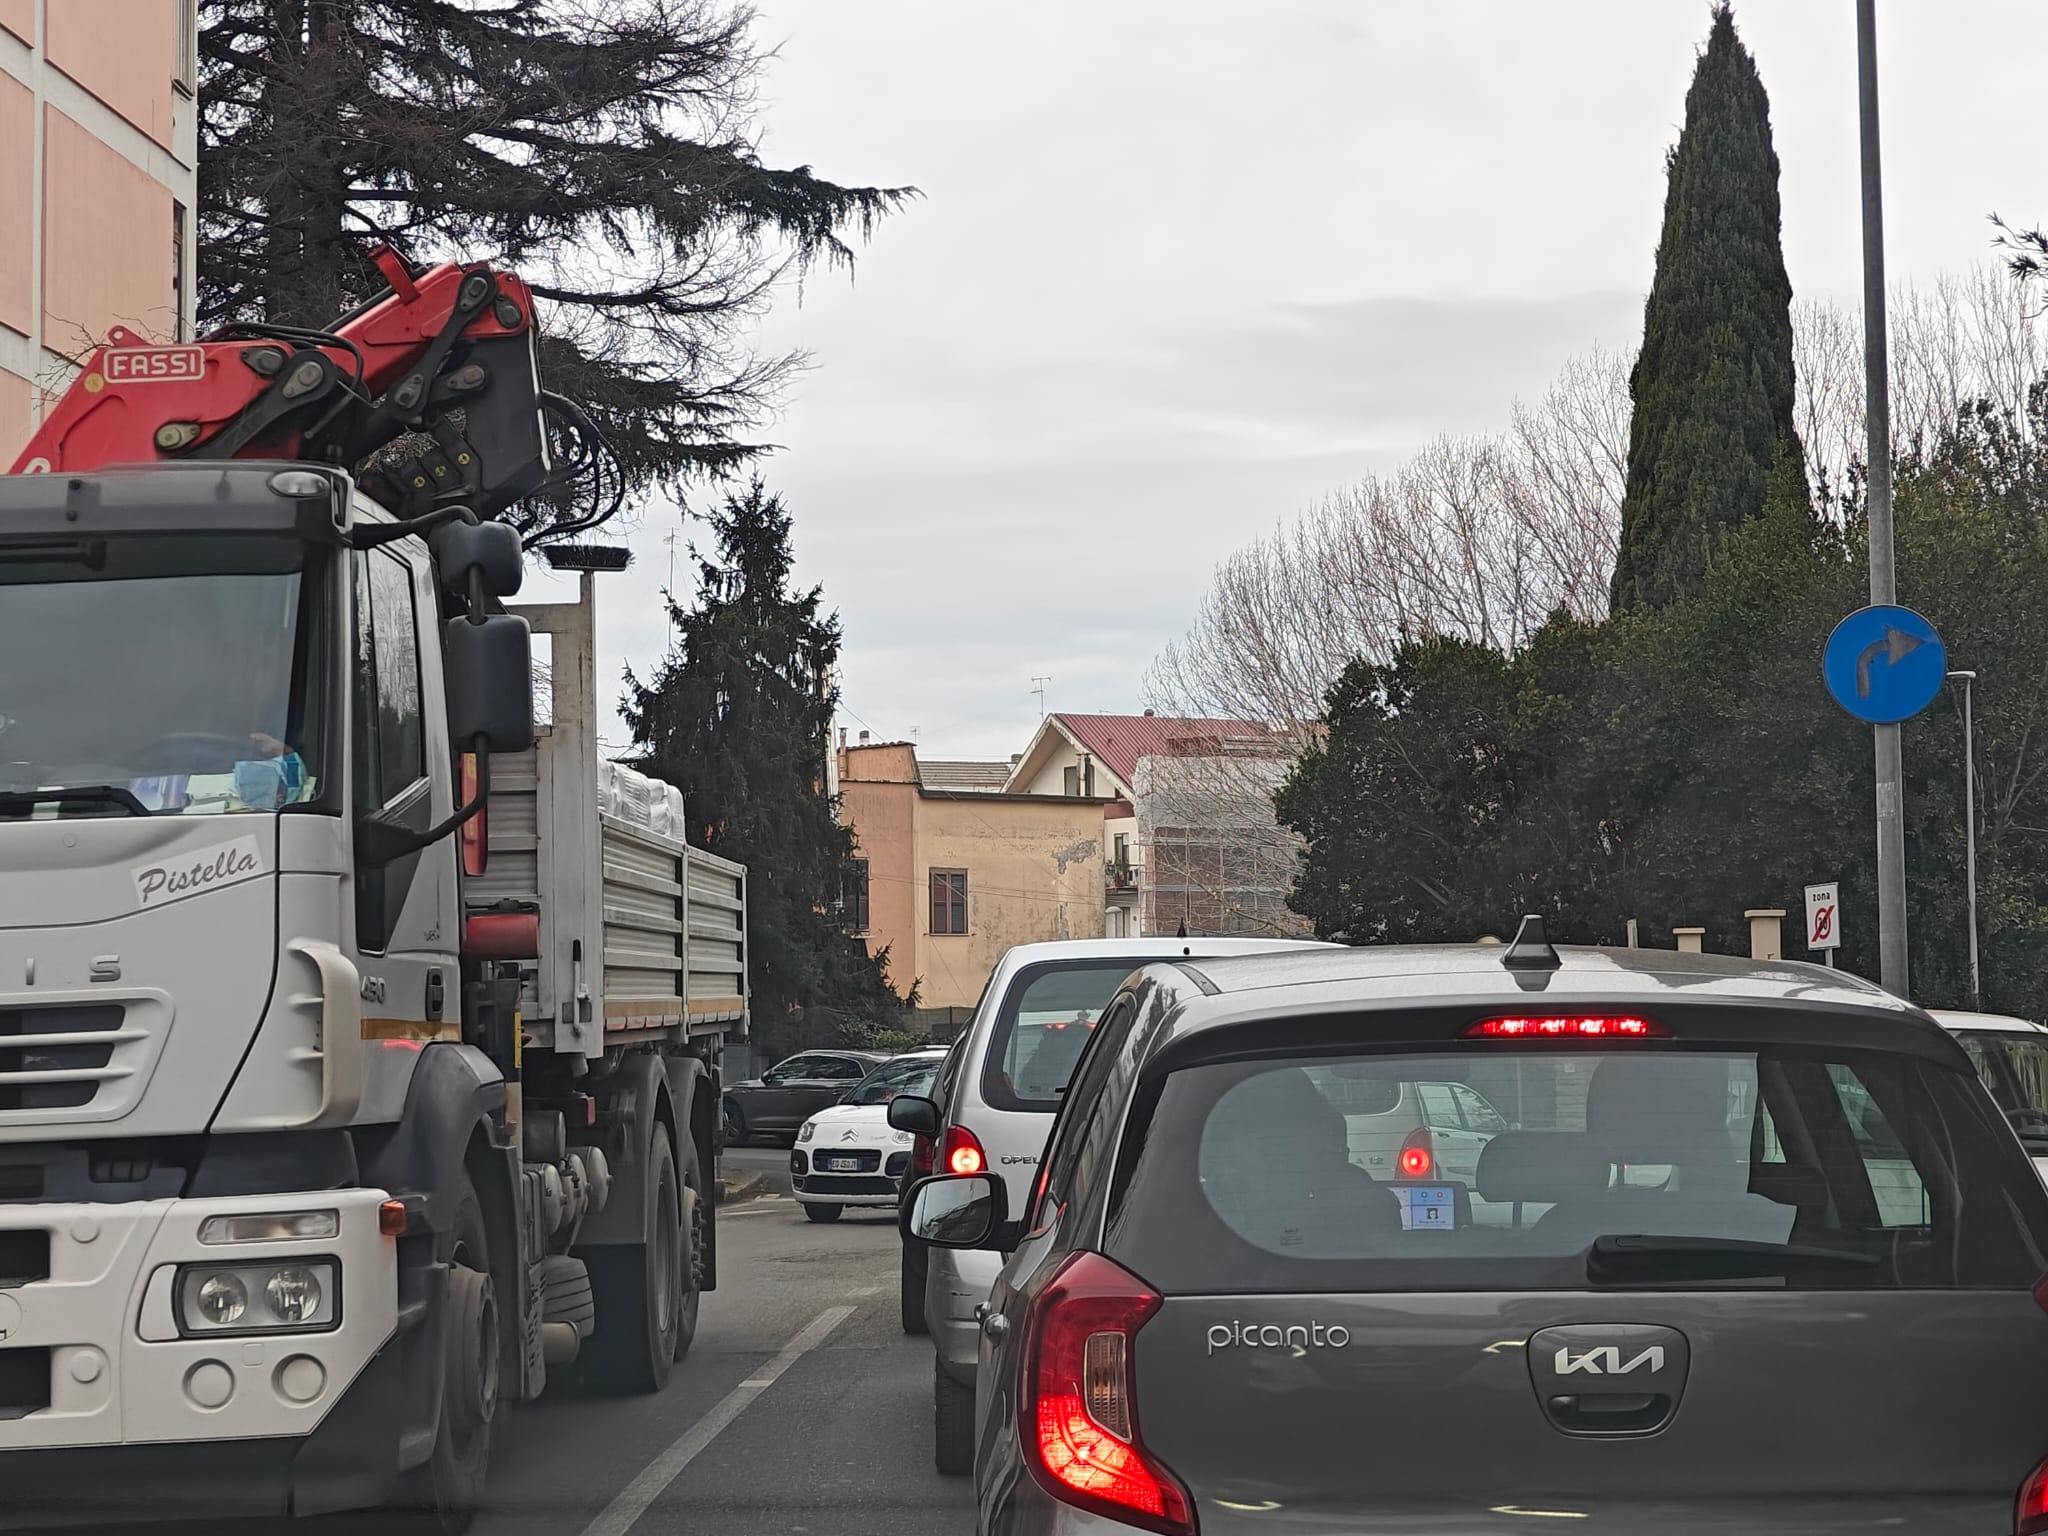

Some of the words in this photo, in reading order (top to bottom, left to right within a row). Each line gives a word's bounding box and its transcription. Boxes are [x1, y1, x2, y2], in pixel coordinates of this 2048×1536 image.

[113, 353, 196, 376] FASSI
[138, 848, 257, 903] Pistella
[1812, 892, 1831, 902] zona
[1001, 1155, 1041, 1165] OPEL
[1207, 1320, 1350, 1356] picanto
[1555, 1346, 1664, 1374] KIA
